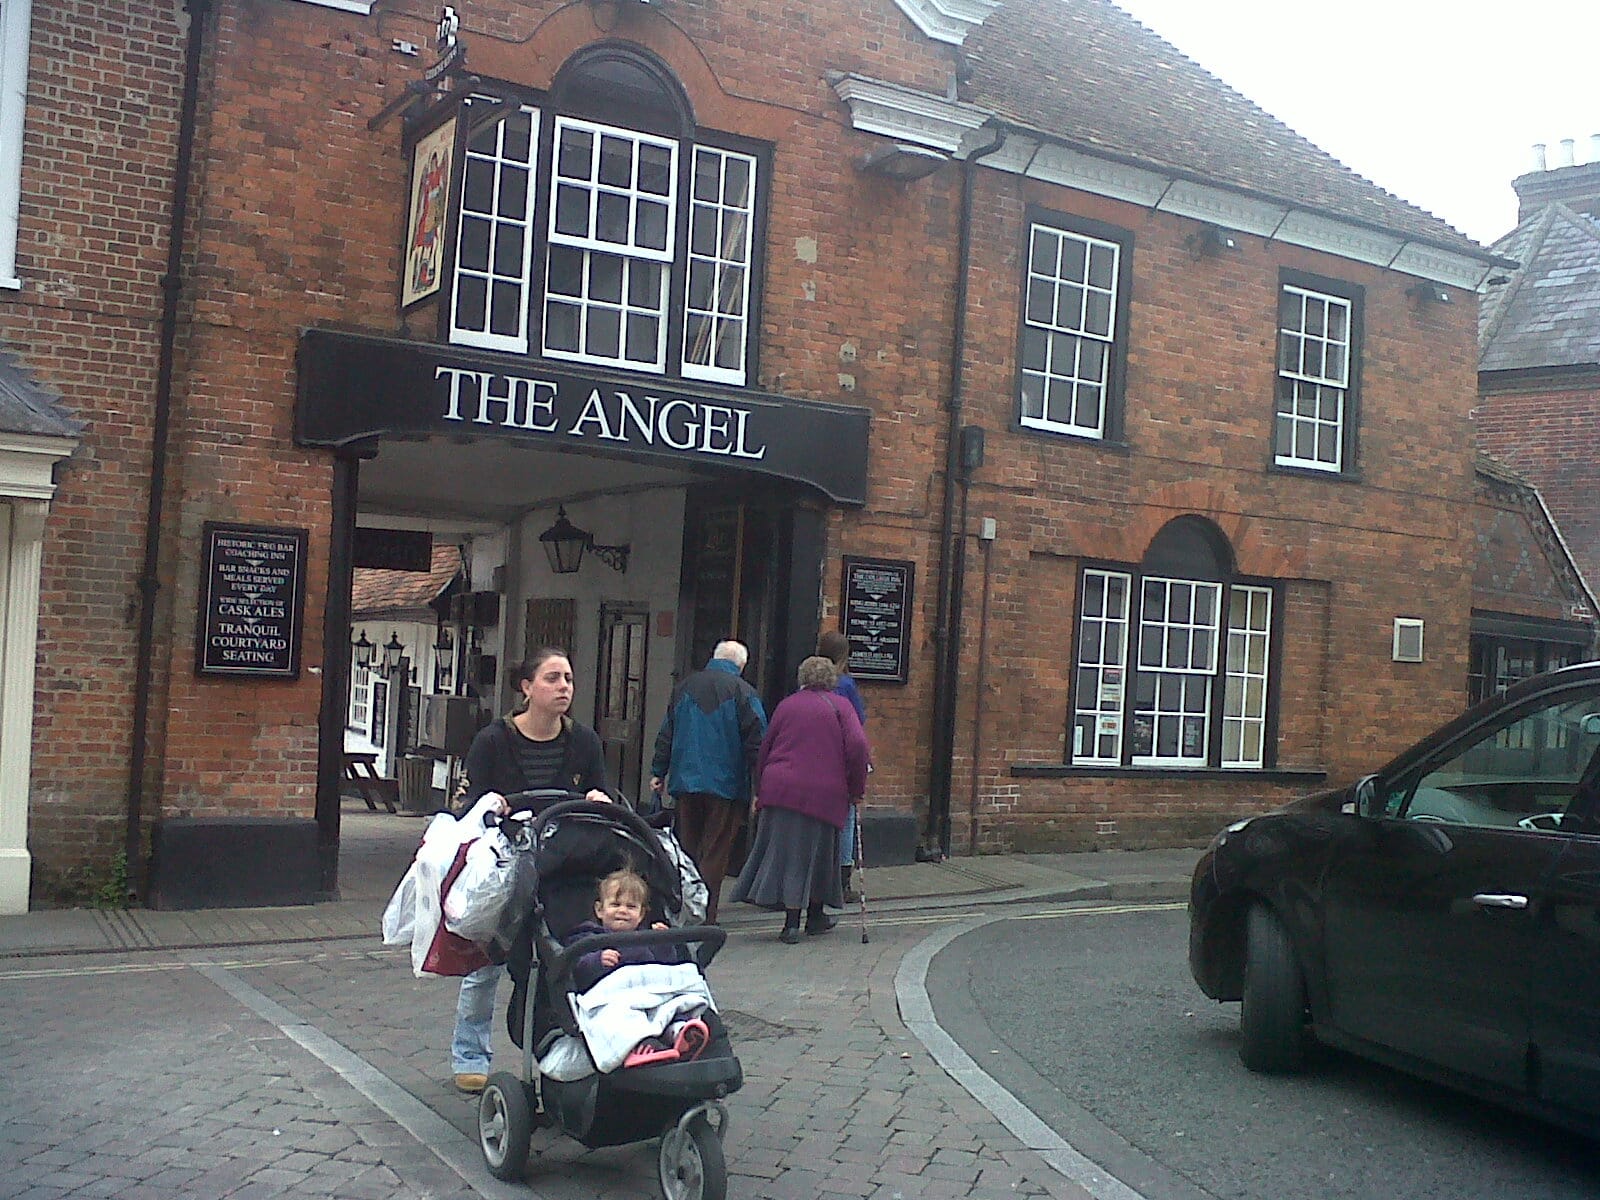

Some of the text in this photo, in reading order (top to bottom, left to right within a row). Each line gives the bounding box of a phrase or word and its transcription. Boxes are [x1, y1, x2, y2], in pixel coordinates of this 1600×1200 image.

[434, 366, 766, 459] THE ANGEL
[217, 538, 255, 548] HISTORIC
[277, 543, 294, 552] BAR
[225, 548, 285, 560] COACHING INN
[219, 563, 290, 576] BAR SNACKS AND
[223, 574, 285, 585] MEALS SERVED
[231, 583, 277, 593] EVERY DAY
[218, 604, 285, 618] CASK ALES
[219, 623, 281, 636] TRANQUIL
[211, 636, 287, 650] COURTYARD
[222, 649, 275, 662] SEATING
